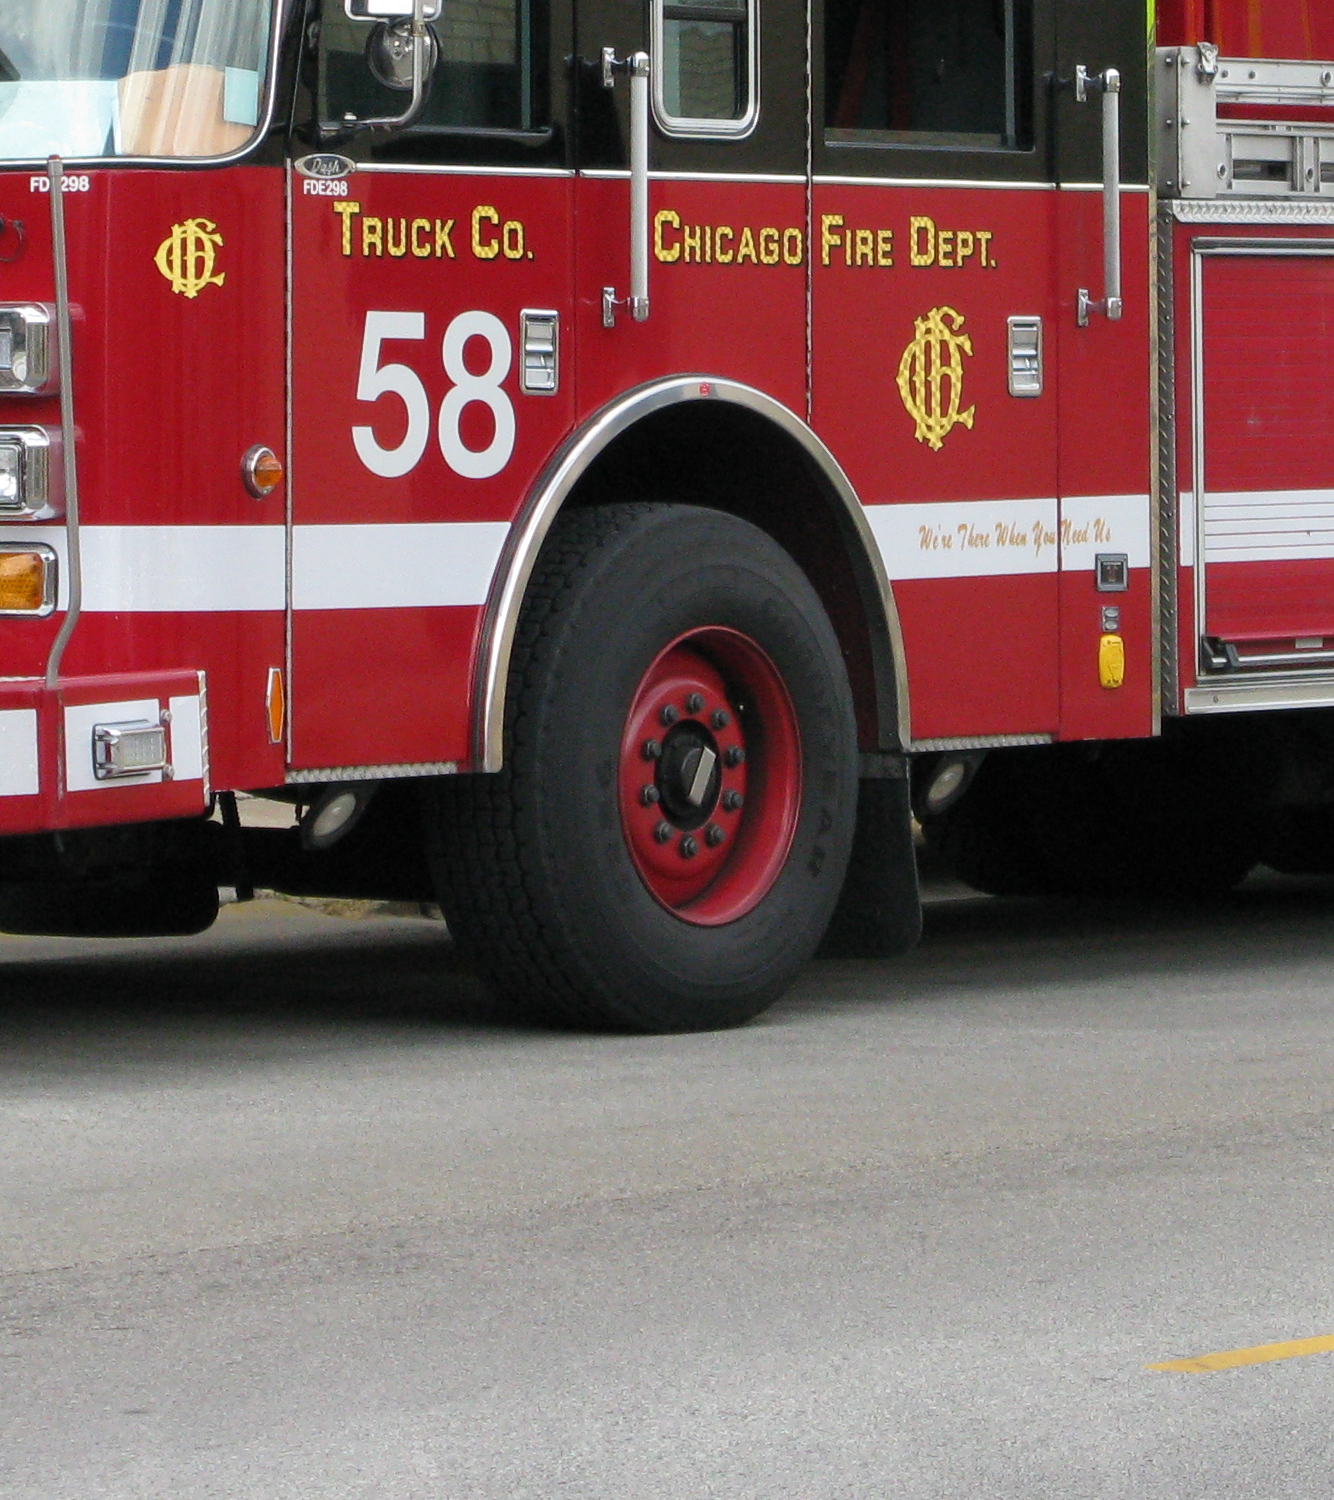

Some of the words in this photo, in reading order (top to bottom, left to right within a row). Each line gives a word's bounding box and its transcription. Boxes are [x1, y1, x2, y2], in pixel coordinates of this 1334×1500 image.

[30, 175, 91, 193] FD298
[303, 179, 348, 197] FDE298
[333, 201, 457, 259] TRUCK
[653, 209, 804, 266] CHICAGO
[820, 213, 895, 268] FIRE
[909, 215, 998, 269] DEPT.
[351, 309, 516, 479] 58
[918, 524, 953, 551] We're
[957, 522, 991, 551] There
[994, 520, 1028, 548] When
[1032, 520, 1056, 559] You
[1060, 518, 1090, 547] Need
[1092, 517, 1112, 546] Us
